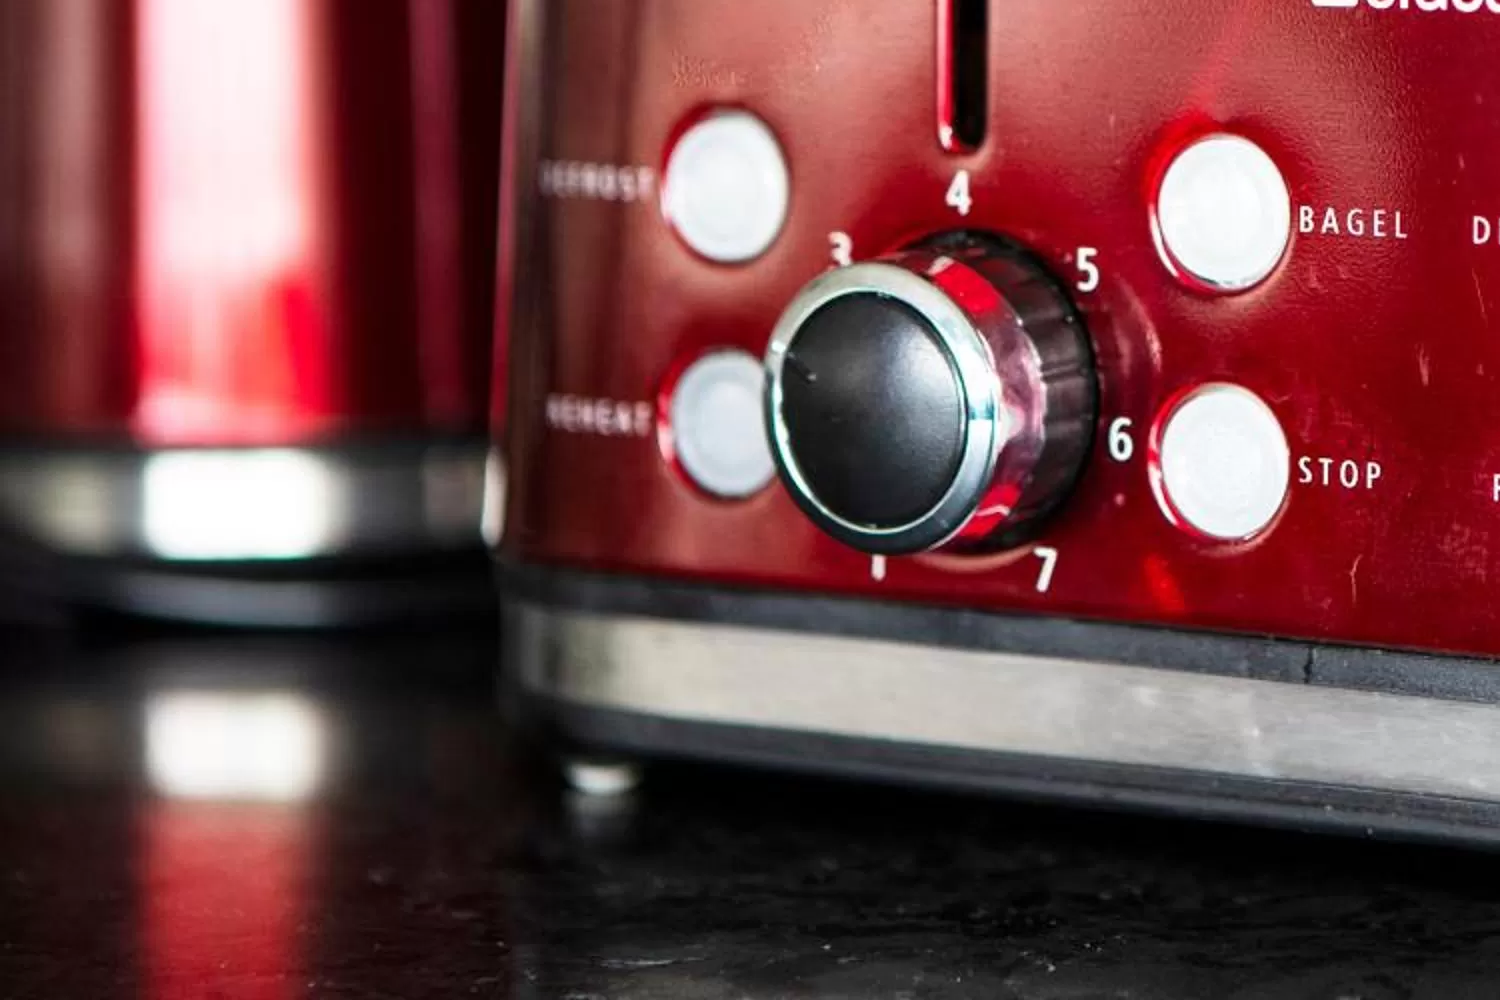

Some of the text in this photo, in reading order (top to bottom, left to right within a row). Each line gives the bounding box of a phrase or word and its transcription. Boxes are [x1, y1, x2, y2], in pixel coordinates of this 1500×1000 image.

[945, 170, 971, 215] 4
[1298, 205, 1409, 239] BAGEL
[828, 230, 853, 267] 3
[1075, 247, 1099, 292] 5
[1107, 418, 1134, 461] 6
[1298, 457, 1382, 489] STOP
[1034, 547, 1058, 592] 7
